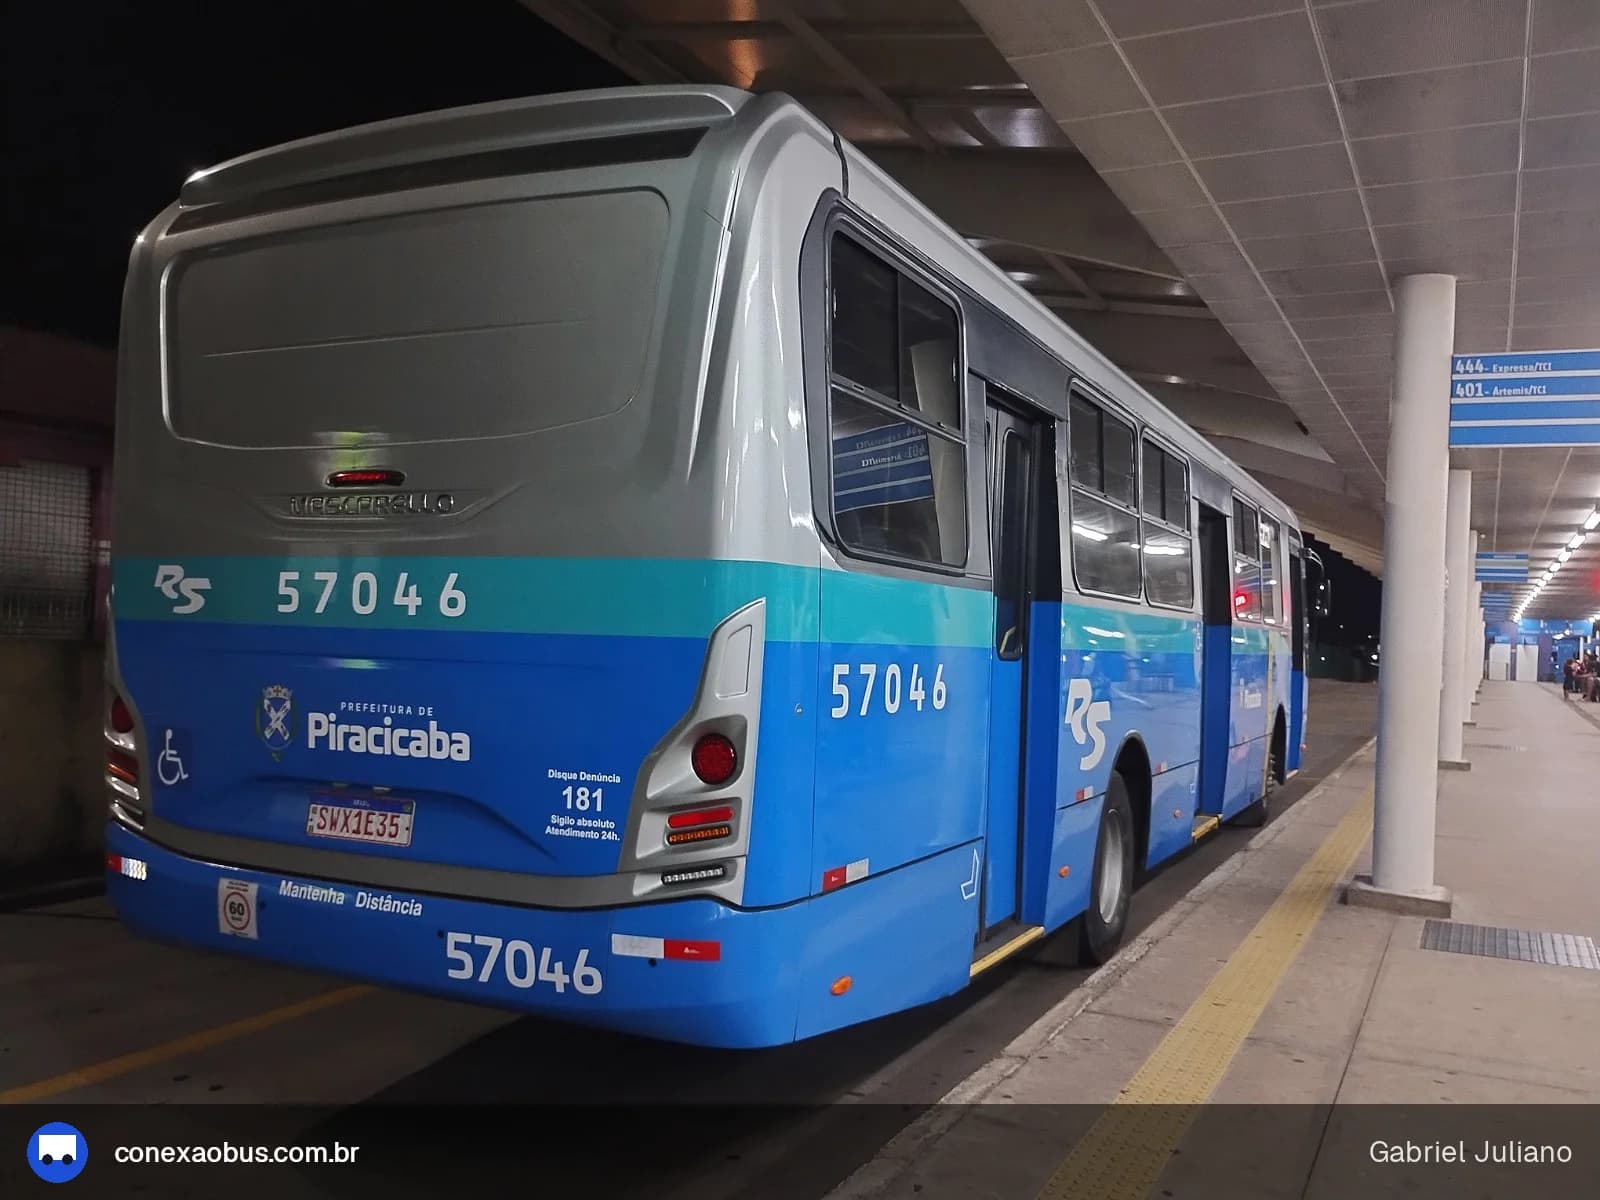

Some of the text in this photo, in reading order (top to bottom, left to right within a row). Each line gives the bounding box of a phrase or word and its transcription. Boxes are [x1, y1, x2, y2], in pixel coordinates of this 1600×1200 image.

[154, 565, 212, 614] RS
[277, 571, 467, 617] 57046
[831, 663, 947, 719] 57046
[340, 702, 434, 717] PREFEITURA DE
[1065, 678, 1111, 771] RS
[308, 712, 471, 762] Piracicaba
[548, 769, 621, 783] Disque Denúncia
[562, 785, 603, 812] 181
[317, 807, 401, 839] SWX1E35
[545, 826, 621, 841] Atendimento 24h.
[551, 814, 616, 829] Sigilo absoluto
[229, 901, 245, 916] 60
[279, 880, 345, 905] Mantenha
[355, 891, 423, 917] Distância
[446, 932, 603, 995] 57046
